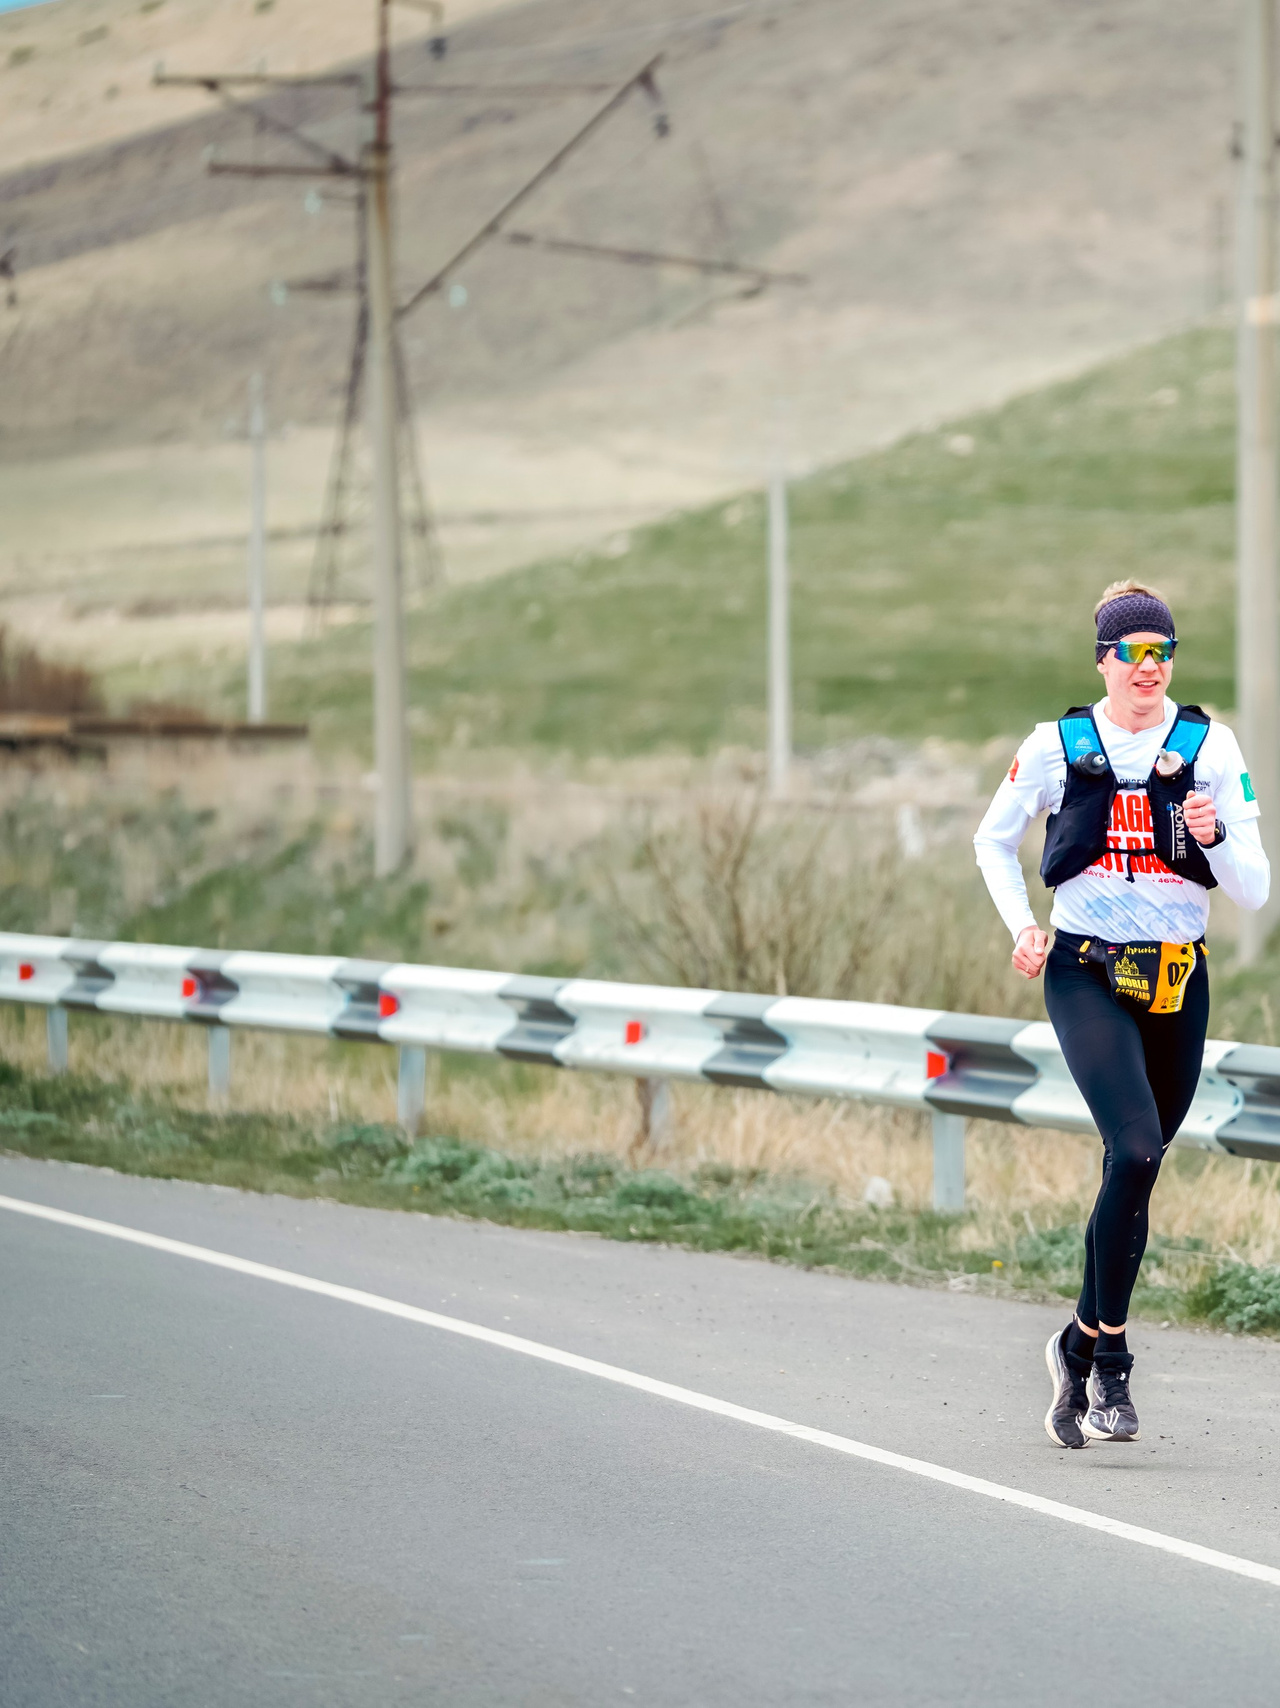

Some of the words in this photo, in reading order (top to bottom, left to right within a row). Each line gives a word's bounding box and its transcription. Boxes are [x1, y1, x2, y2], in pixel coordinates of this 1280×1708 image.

[1107, 793, 1154, 833] AGE
[1173, 803, 1187, 859] AONIJIE
[1114, 976, 1149, 991] WORLD
[1167, 961, 1189, 987] 07
